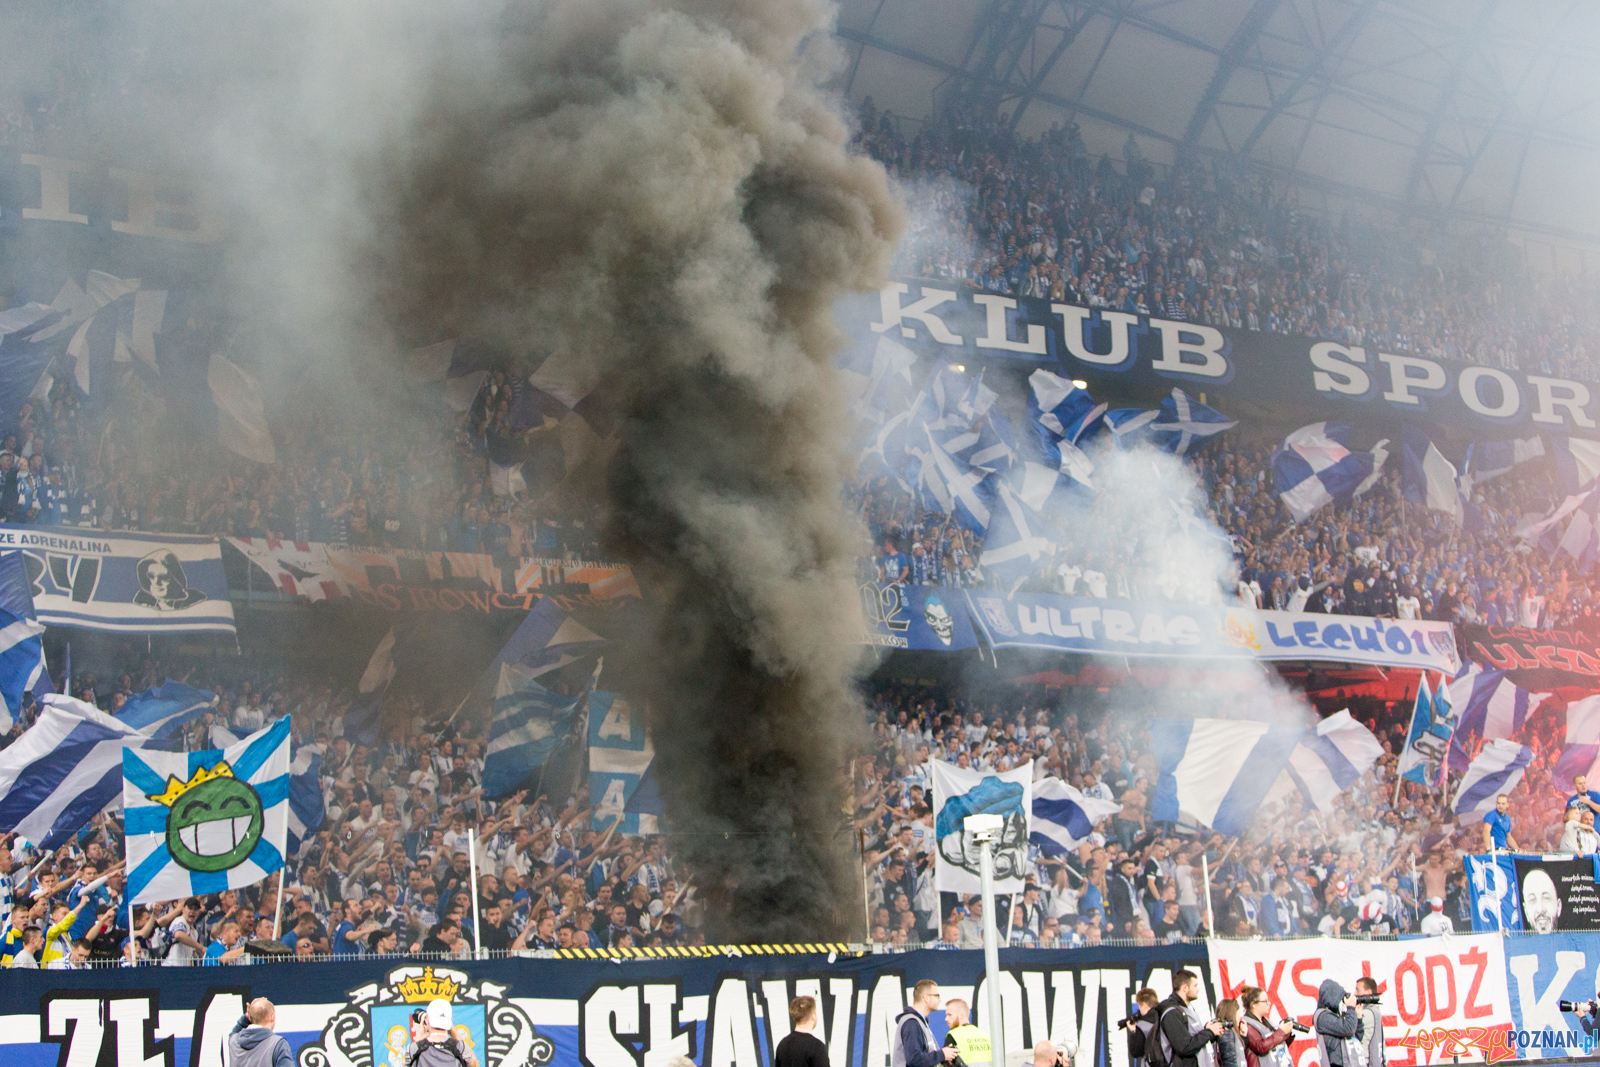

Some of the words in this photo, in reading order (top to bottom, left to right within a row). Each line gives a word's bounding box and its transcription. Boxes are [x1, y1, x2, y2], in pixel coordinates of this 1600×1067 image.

[871, 281, 1228, 377] KLUB
[1309, 341, 1597, 428] SPOR
[21, 534, 112, 553] ADRENALINA
[1017, 603, 1202, 645] ULTRAS
[1218, 957, 1325, 1030] ŁKS
[1509, 951, 1600, 1058] K
